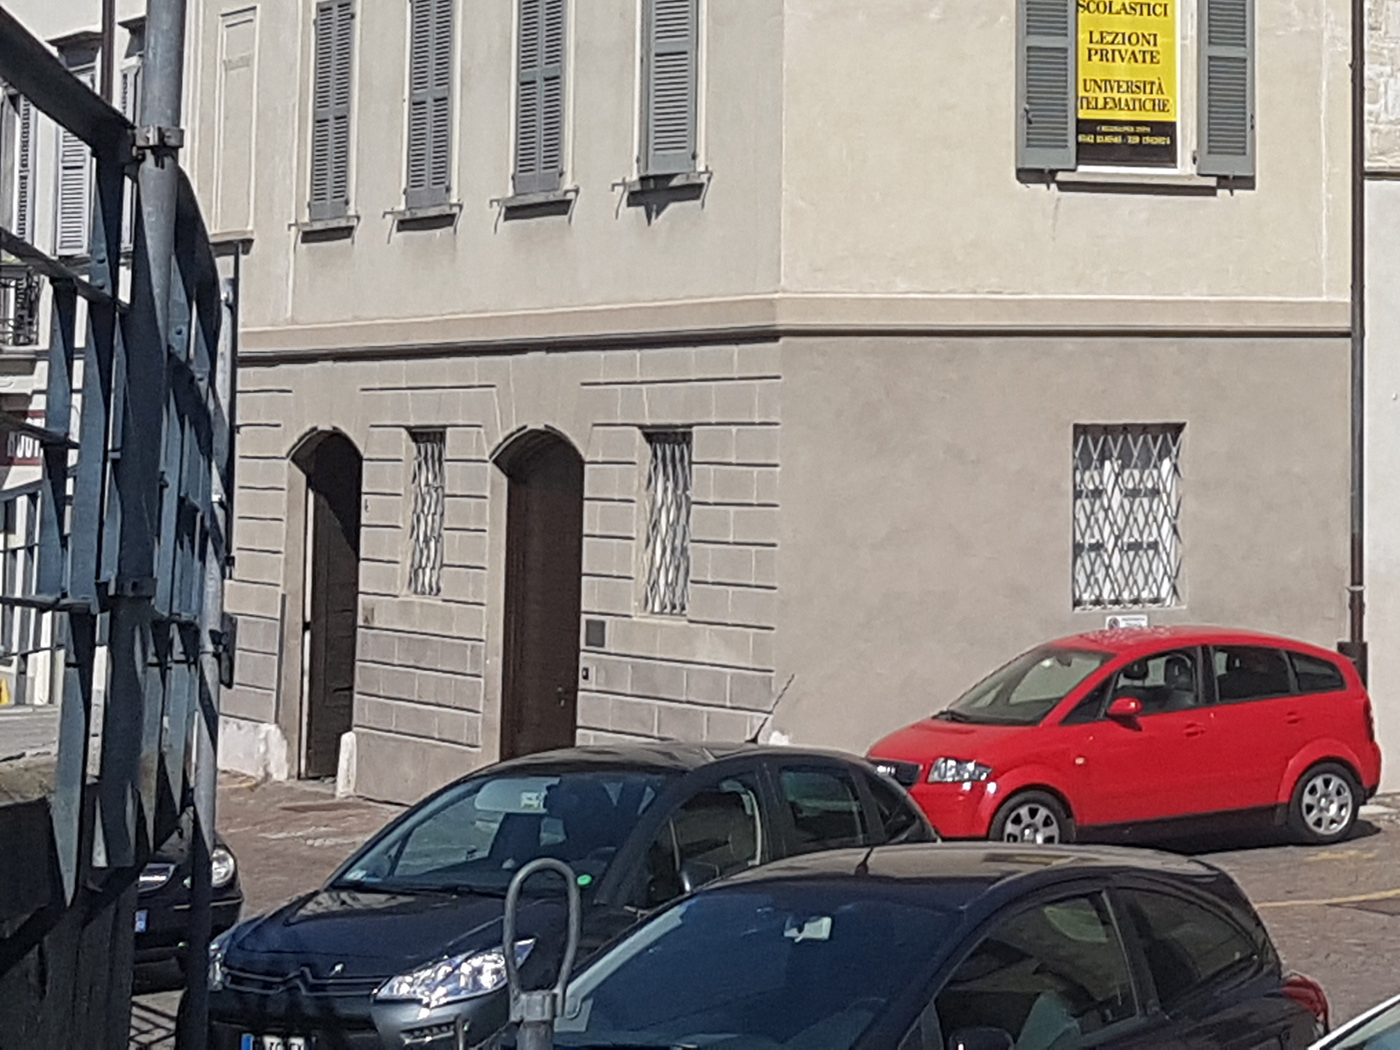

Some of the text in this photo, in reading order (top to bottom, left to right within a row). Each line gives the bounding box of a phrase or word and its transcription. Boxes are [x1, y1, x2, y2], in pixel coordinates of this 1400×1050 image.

[1077, 0, 1169, 17] SCOLASTICI
[1089, 30, 1159, 47] LEZIONI
[1087, 47, 1160, 64] PRIVATE
[1083, 76, 1165, 95] UNIVERSITÀ
[1079, 96, 1170, 113] TELEMATICHE
